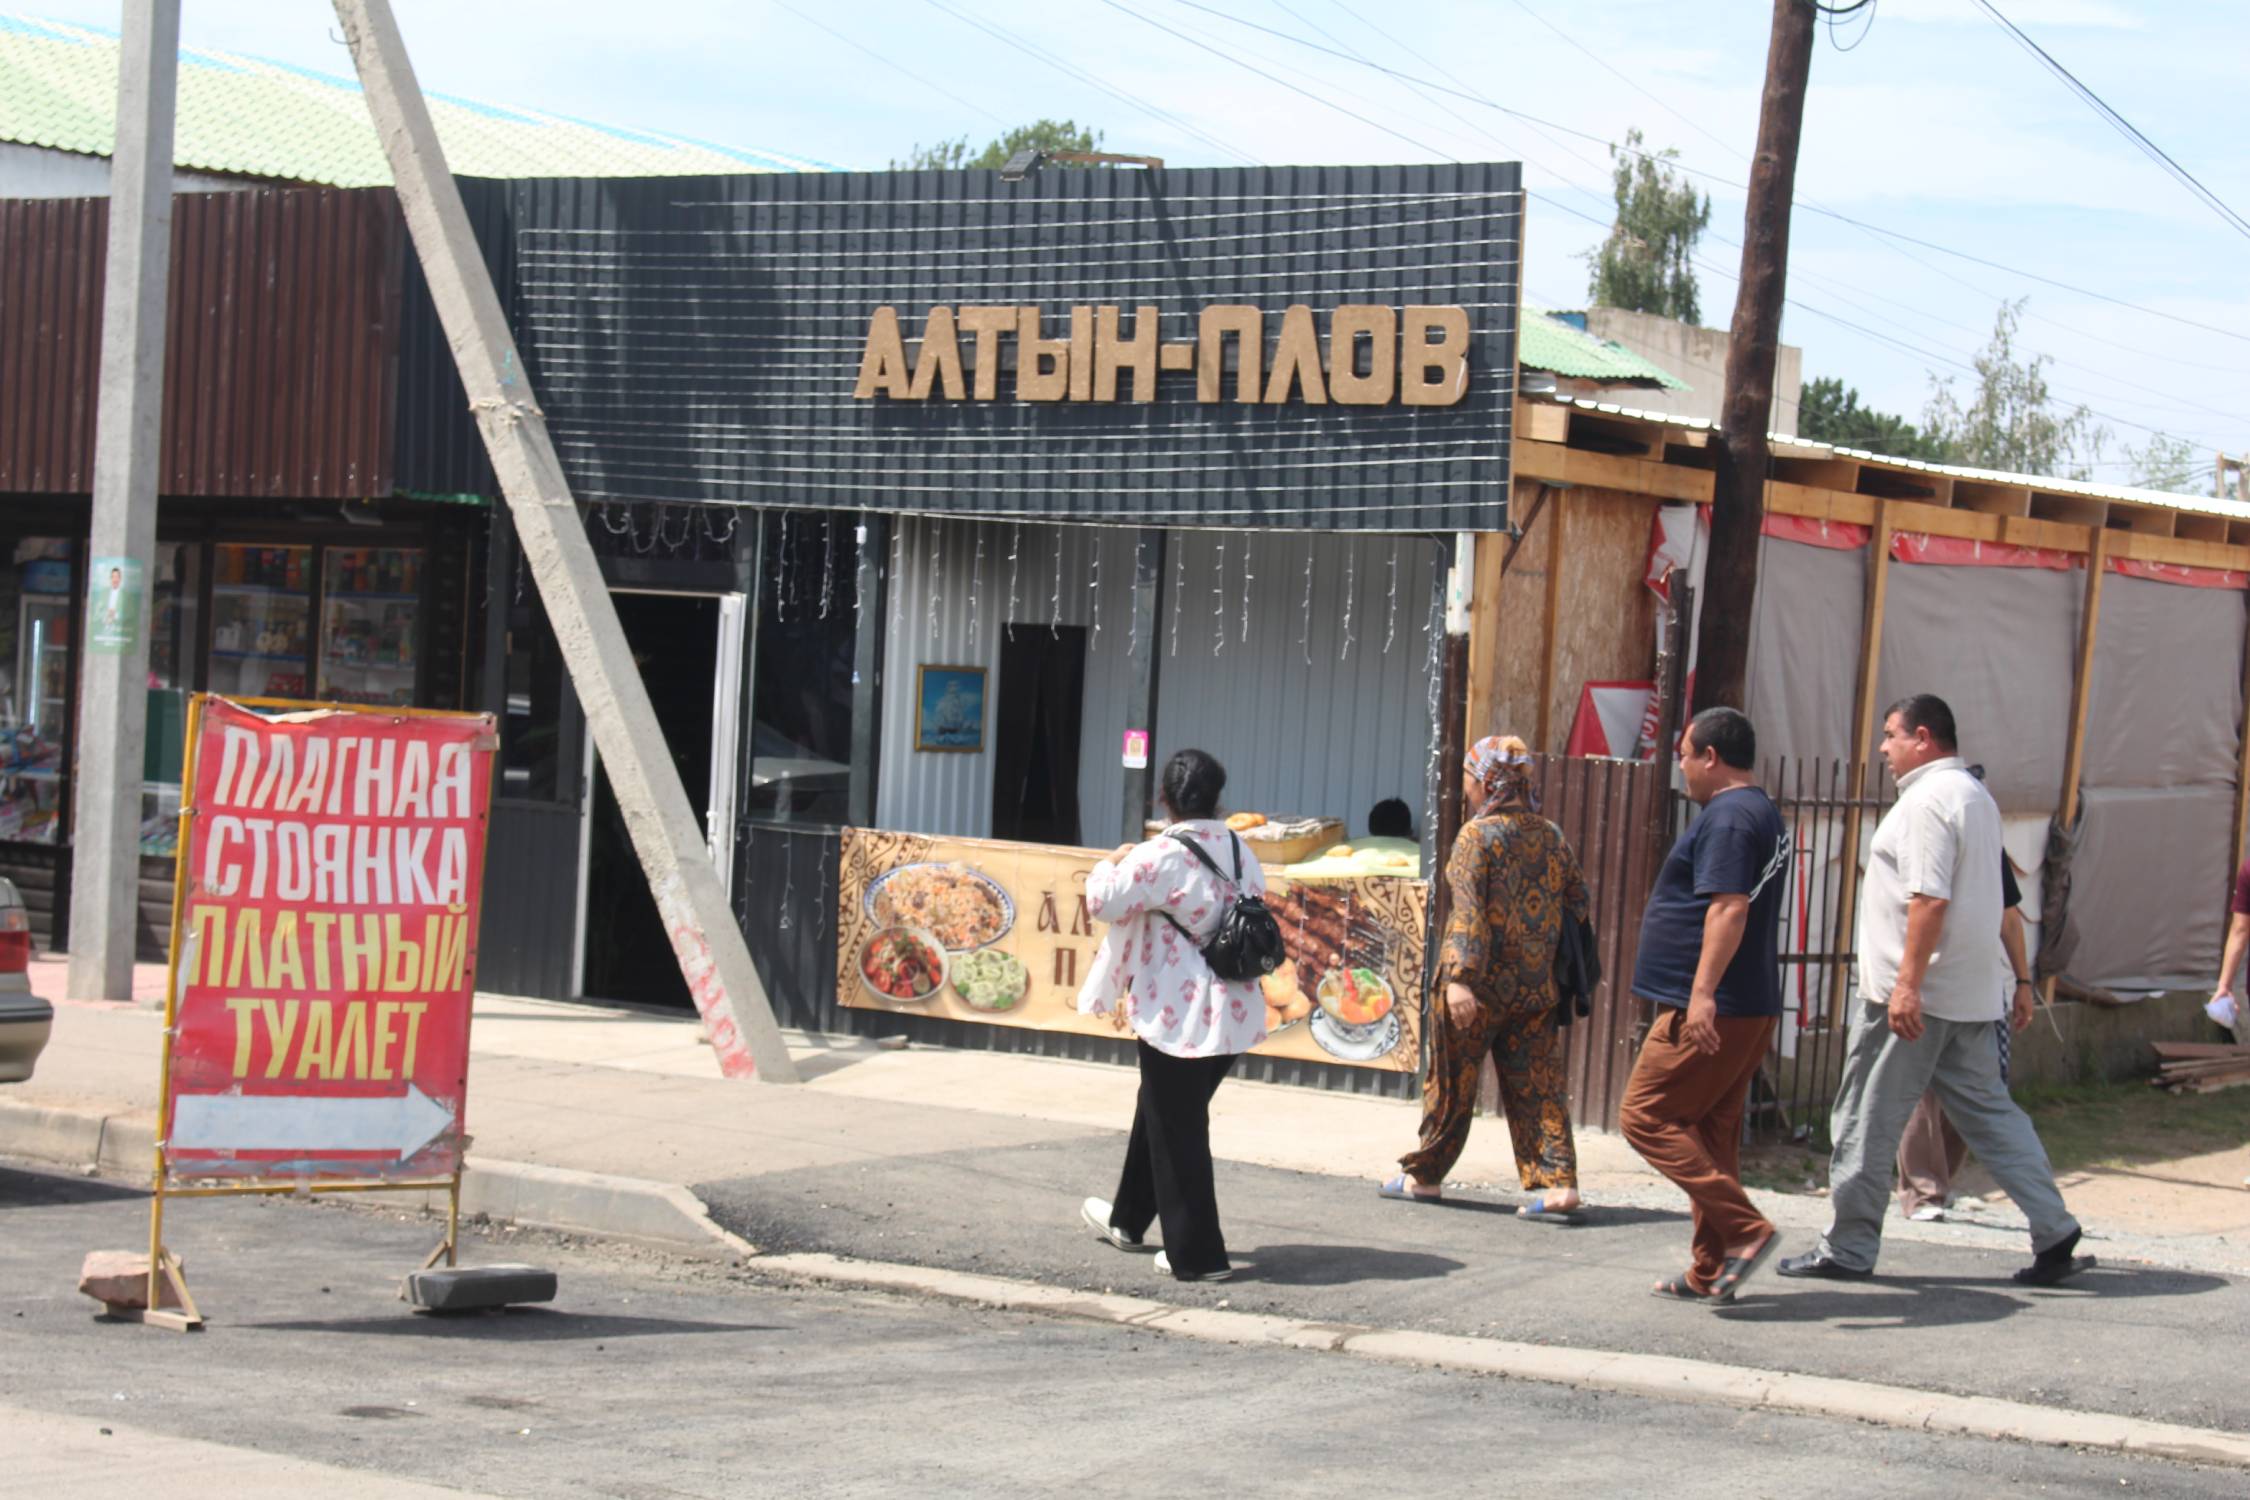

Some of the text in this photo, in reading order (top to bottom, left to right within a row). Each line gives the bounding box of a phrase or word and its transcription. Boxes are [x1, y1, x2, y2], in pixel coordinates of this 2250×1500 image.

[853, 304, 1470, 405] АЛТЫН-ПЛОВ
[203, 815, 468, 905] СТОЯНКА
[187, 902, 468, 992] ПЛАТНЫЙ
[226, 997, 428, 1080] ТУАЛЕТ
